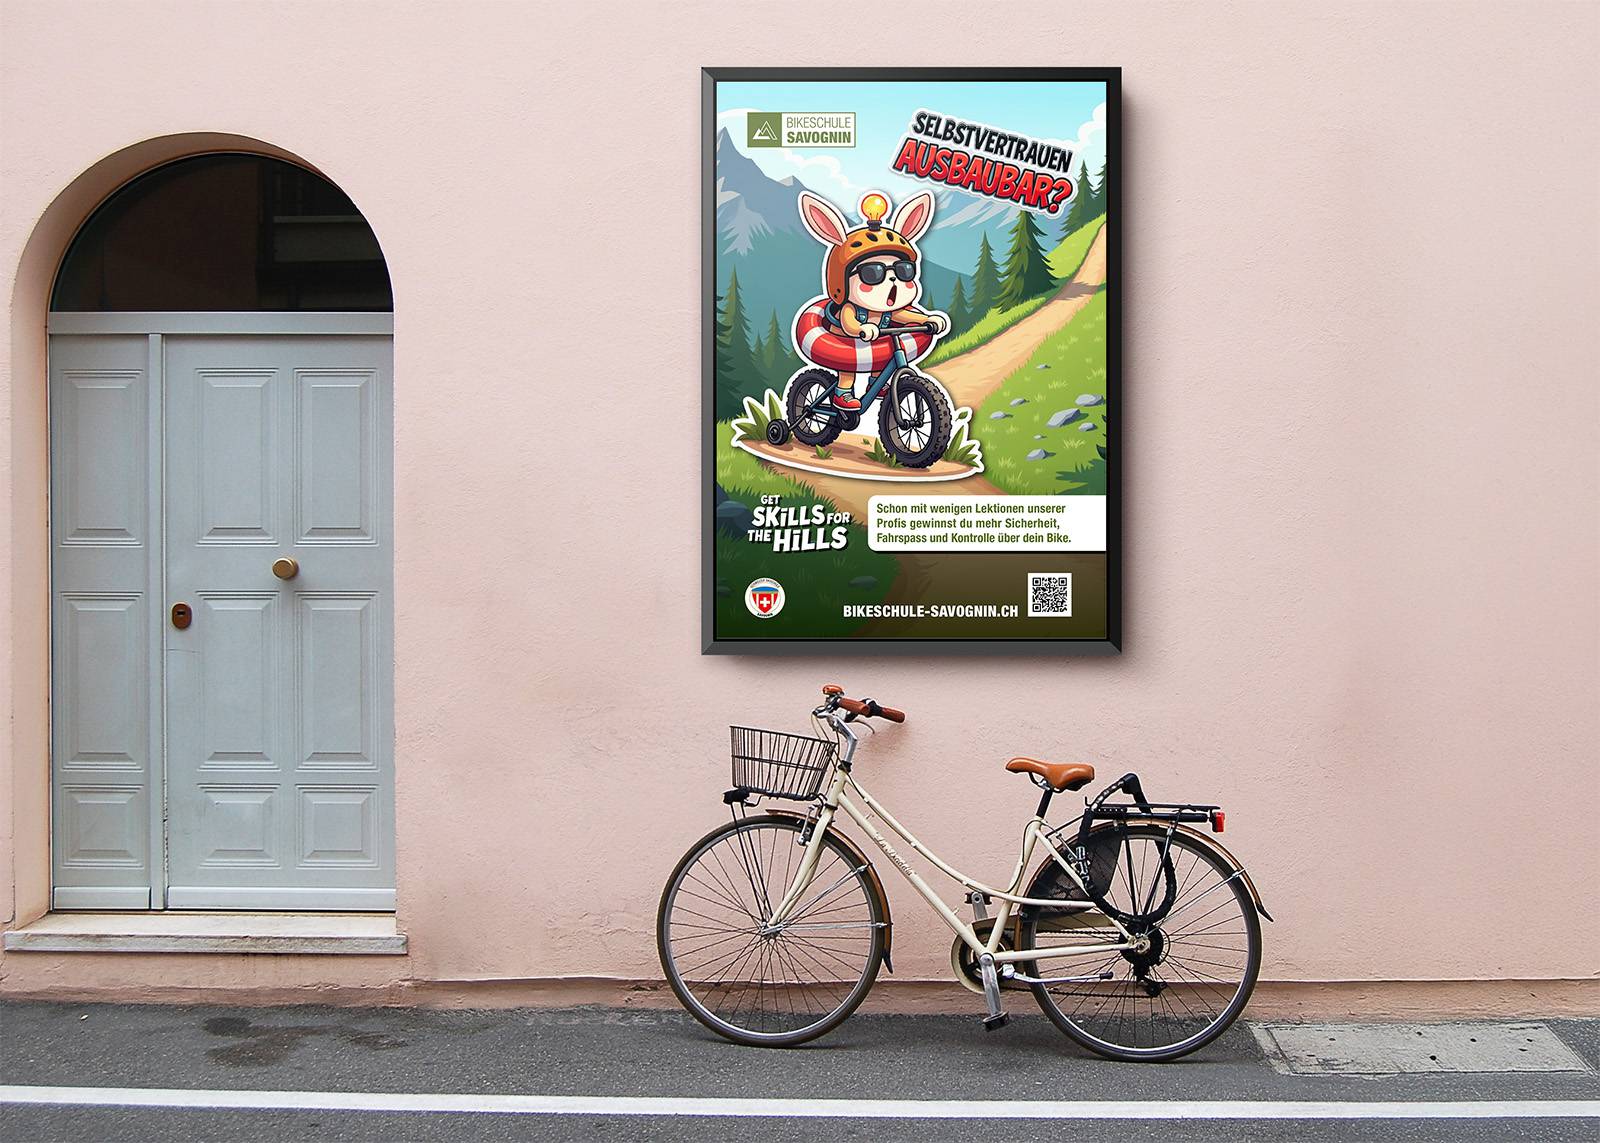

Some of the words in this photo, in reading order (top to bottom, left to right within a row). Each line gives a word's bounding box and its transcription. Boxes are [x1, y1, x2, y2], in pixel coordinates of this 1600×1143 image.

[786, 116, 851, 128] BIKESCHULE
[787, 131, 851, 143] SAVOGNIN
[912, 111, 1073, 173] SELBSTVERTRAUEN
[894, 137, 1073, 214] AUSBAUBAR?
[760, 494, 780, 504] GET
[876, 503, 907, 513] Schon
[911, 503, 927, 513] mit
[930, 503, 972, 515] wenigen
[975, 503, 1024, 513] Lektionen
[1027, 505, 1066, 513] unserer
[826, 511, 851, 524] FOR
[876, 518, 906, 528] Profis
[910, 518, 956, 530] gewinnst
[960, 518, 972, 528] du
[975, 518, 1002, 528] mehr
[1005, 518, 1060, 529] Sicherheit,
[747, 529, 772, 542] THE
[876, 533, 927, 544] Fahrspass
[930, 533, 948, 543] und
[951, 533, 995, 543] Kontrolle
[998, 533, 1020, 543] über
[1023, 533, 1044, 543] dein
[1047, 533, 1072, 543] Bike.
[843, 604, 1019, 618] BIKESCHULE-SAVOGNIN.CH
